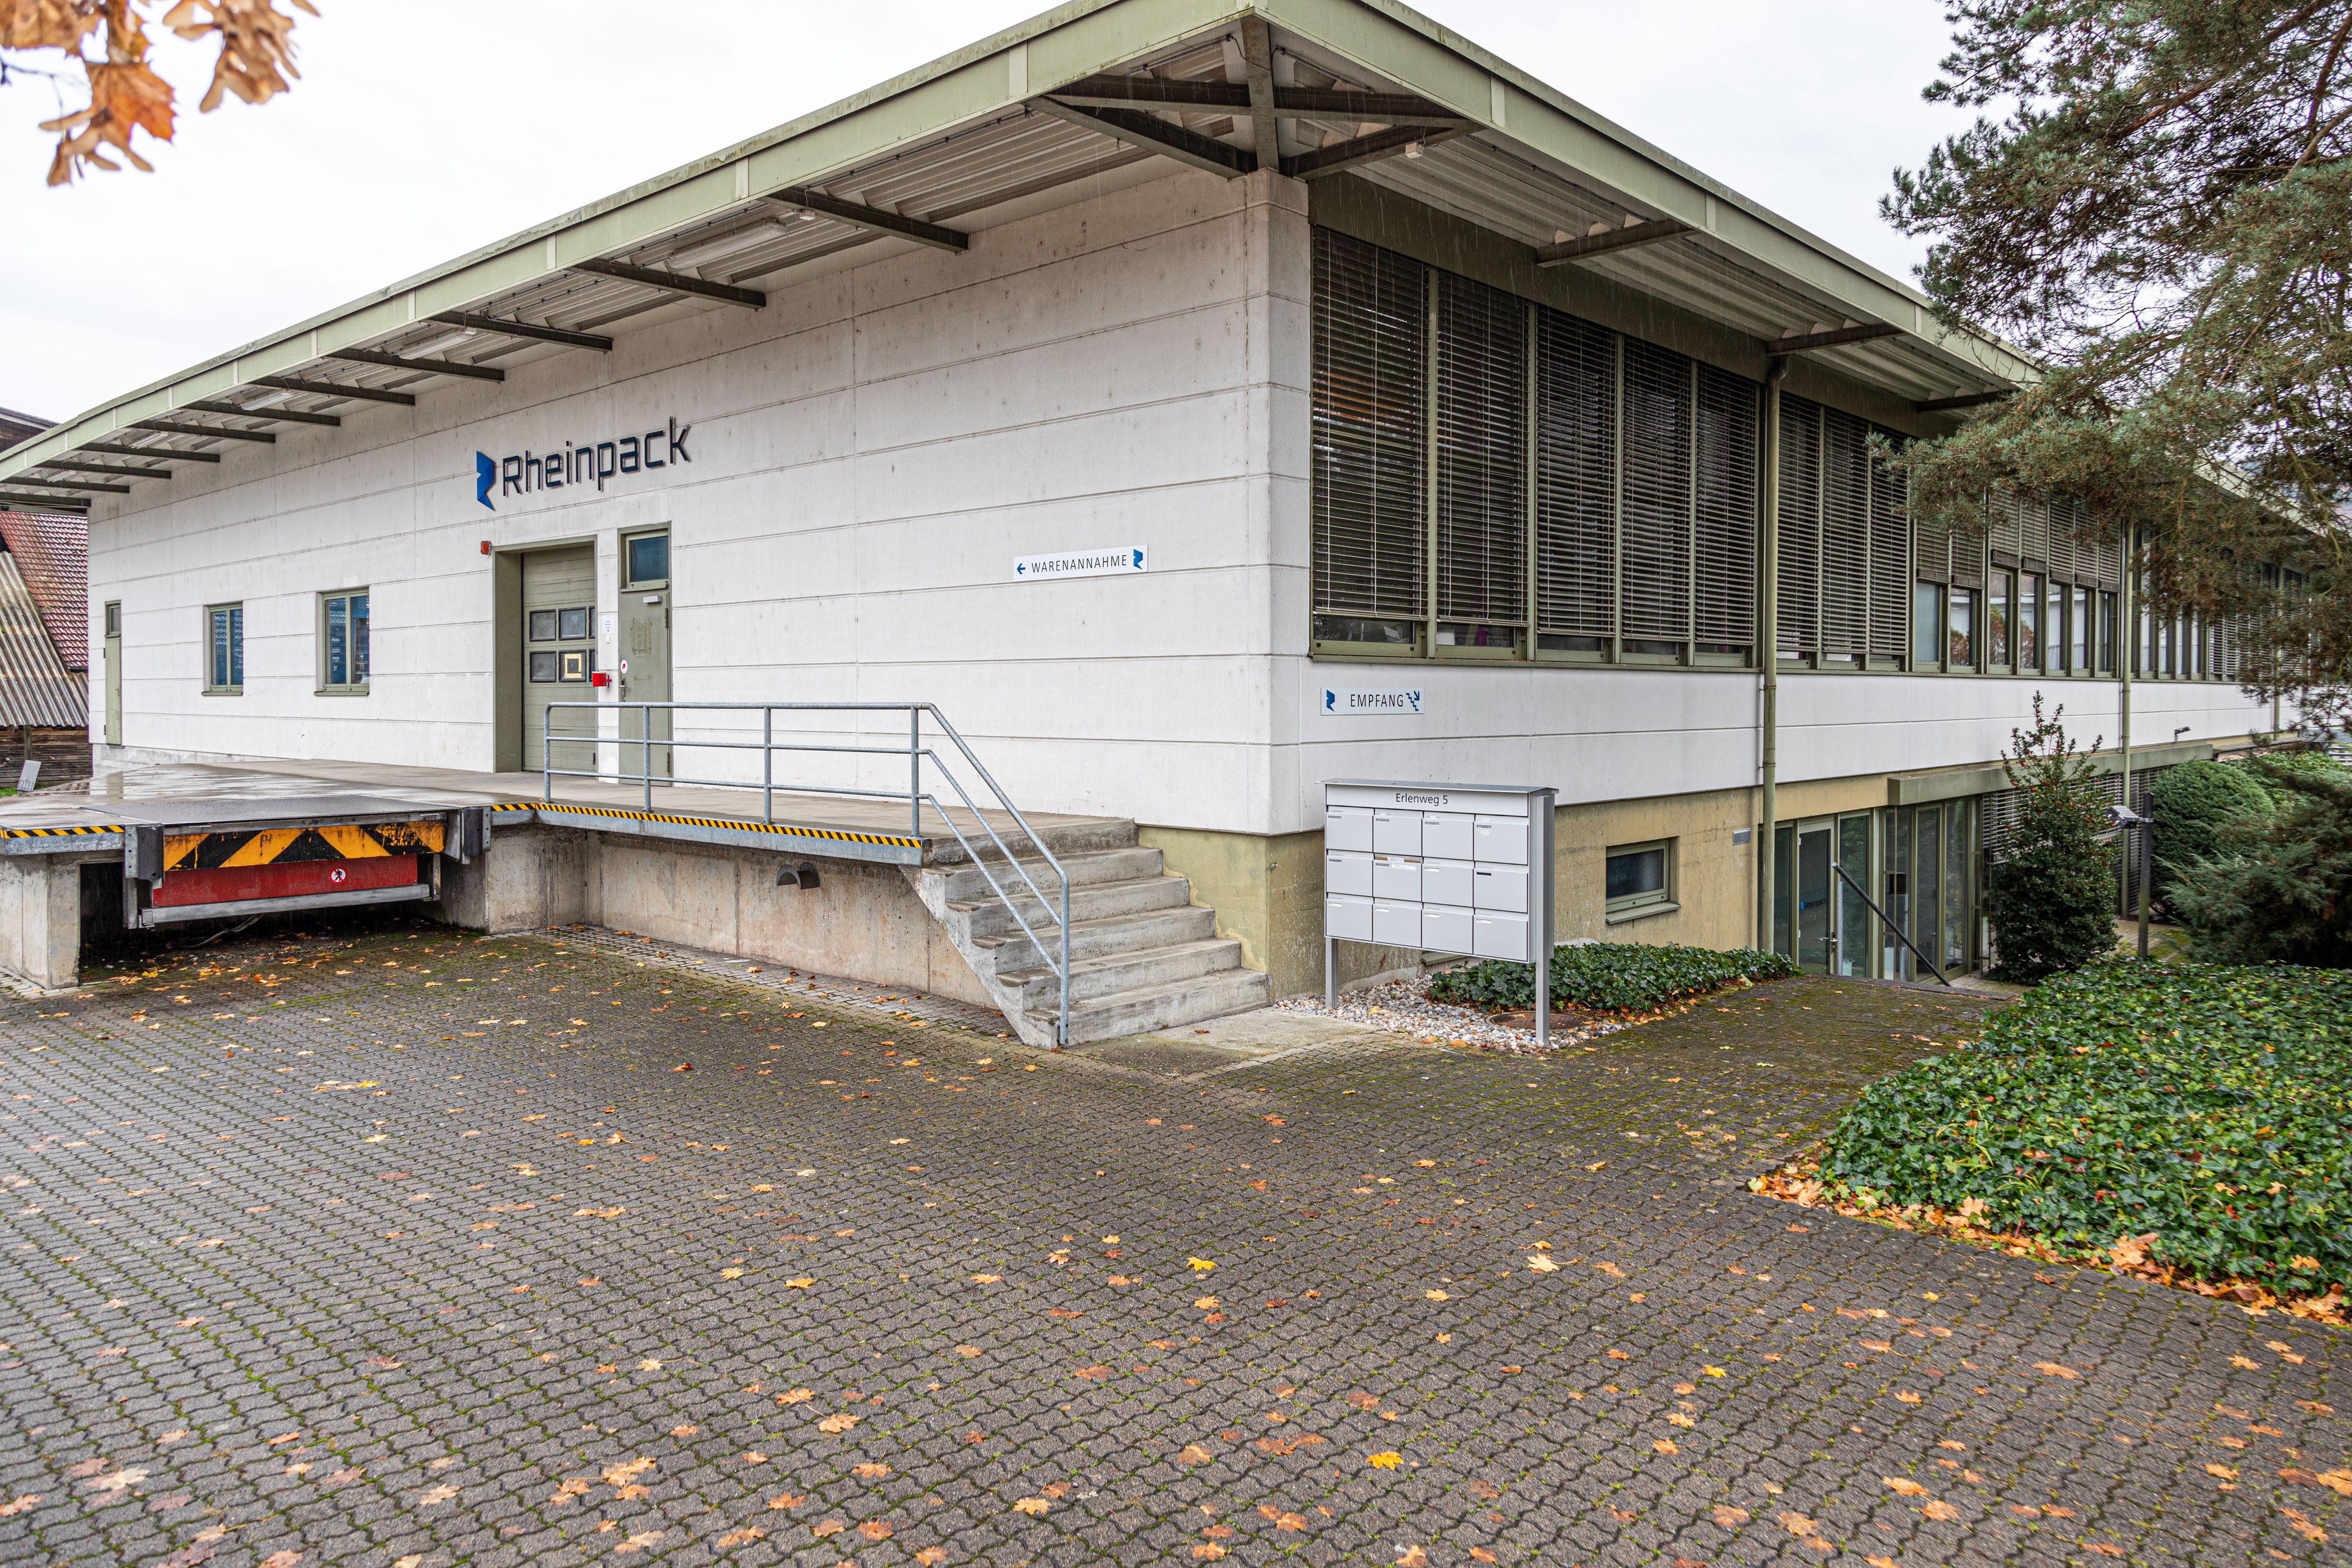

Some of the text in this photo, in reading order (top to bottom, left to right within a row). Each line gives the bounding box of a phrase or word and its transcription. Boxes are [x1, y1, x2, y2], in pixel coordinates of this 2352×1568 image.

[503, 416, 690, 496] Rheinpack
[1031, 554, 1127, 573] WARENANNAHME
[1351, 694, 1404, 707] EMPFANG
[1396, 793, 1448, 806] Erlenweg 5
